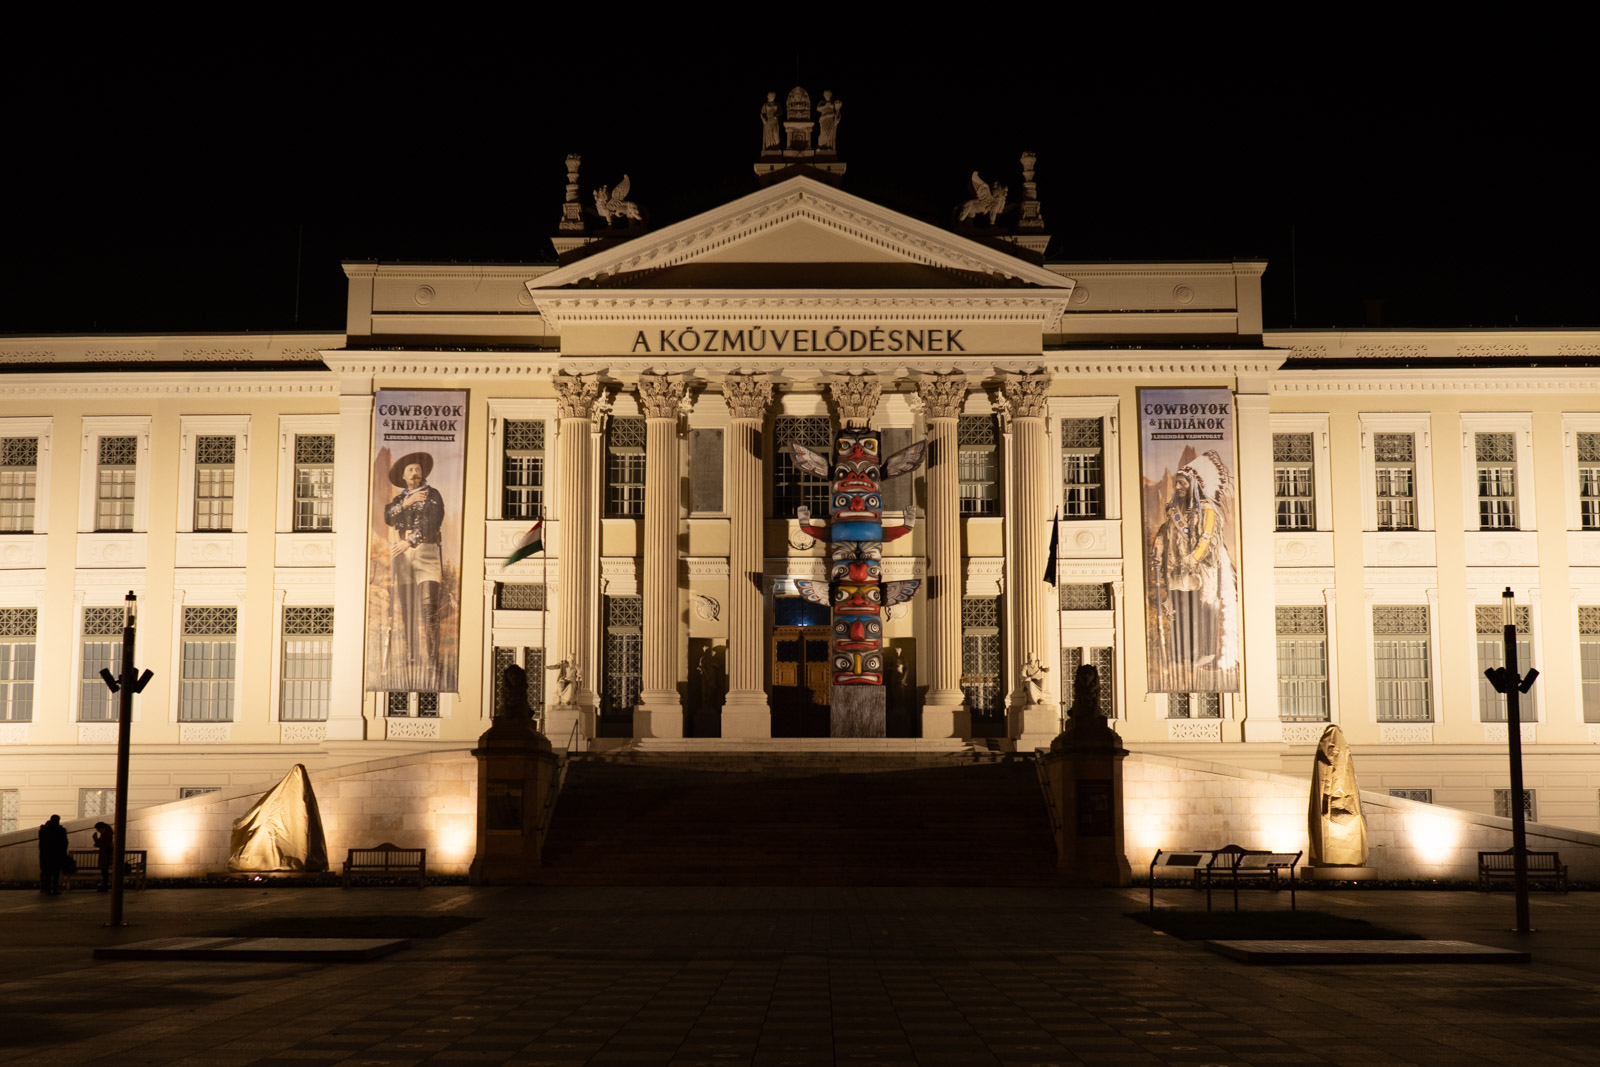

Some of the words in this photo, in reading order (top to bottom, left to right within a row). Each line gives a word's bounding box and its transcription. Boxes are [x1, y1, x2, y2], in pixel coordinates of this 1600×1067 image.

[632, 331, 651, 352] A
[379, 405, 462, 416] COWBOYOK
[1144, 404, 1229, 415] COWBOYOK
[383, 419, 390, 427] &
[391, 417, 457, 431] INDIÁNOK
[1149, 418, 1156, 427] &
[1158, 416, 1224, 429] INDIÁNOK
